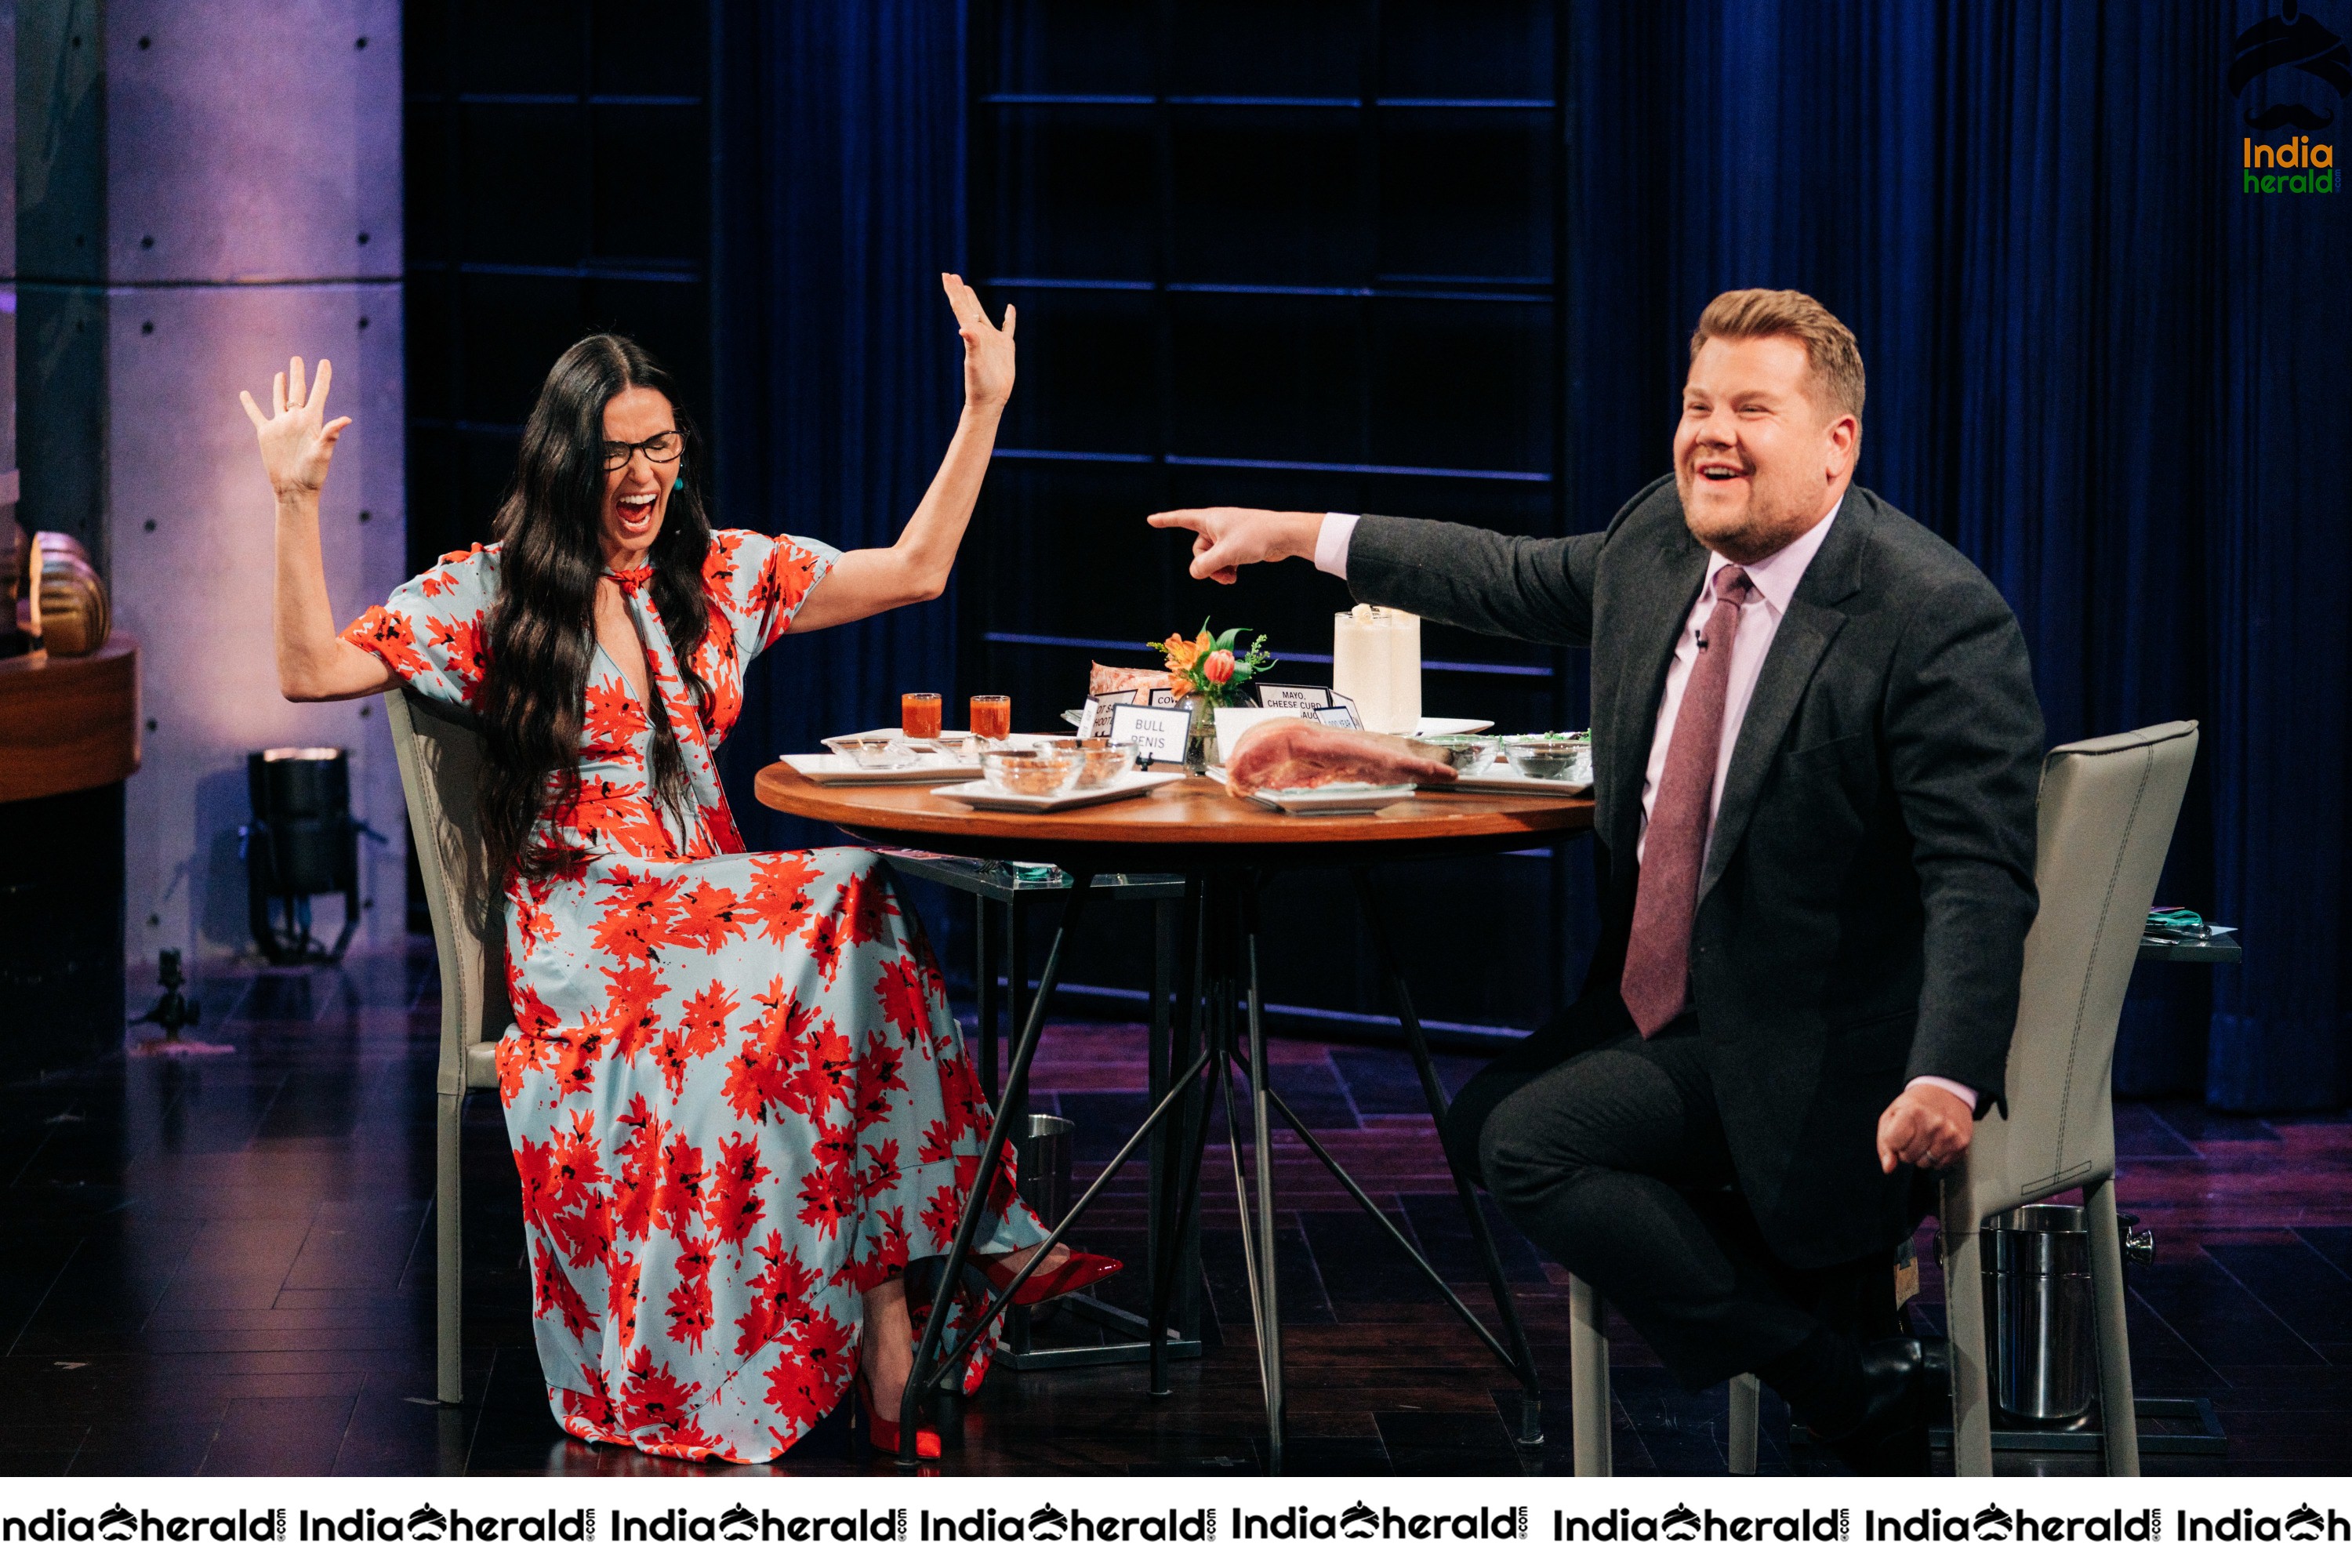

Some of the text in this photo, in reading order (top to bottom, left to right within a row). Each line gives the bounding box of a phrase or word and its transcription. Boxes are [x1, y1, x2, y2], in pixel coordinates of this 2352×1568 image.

[1267, 699, 1298, 709] CHEESE
[1301, 710, 1319, 720] AUC
[1135, 718, 1165, 732] BULL
[1131, 735, 1166, 749] PENIS
